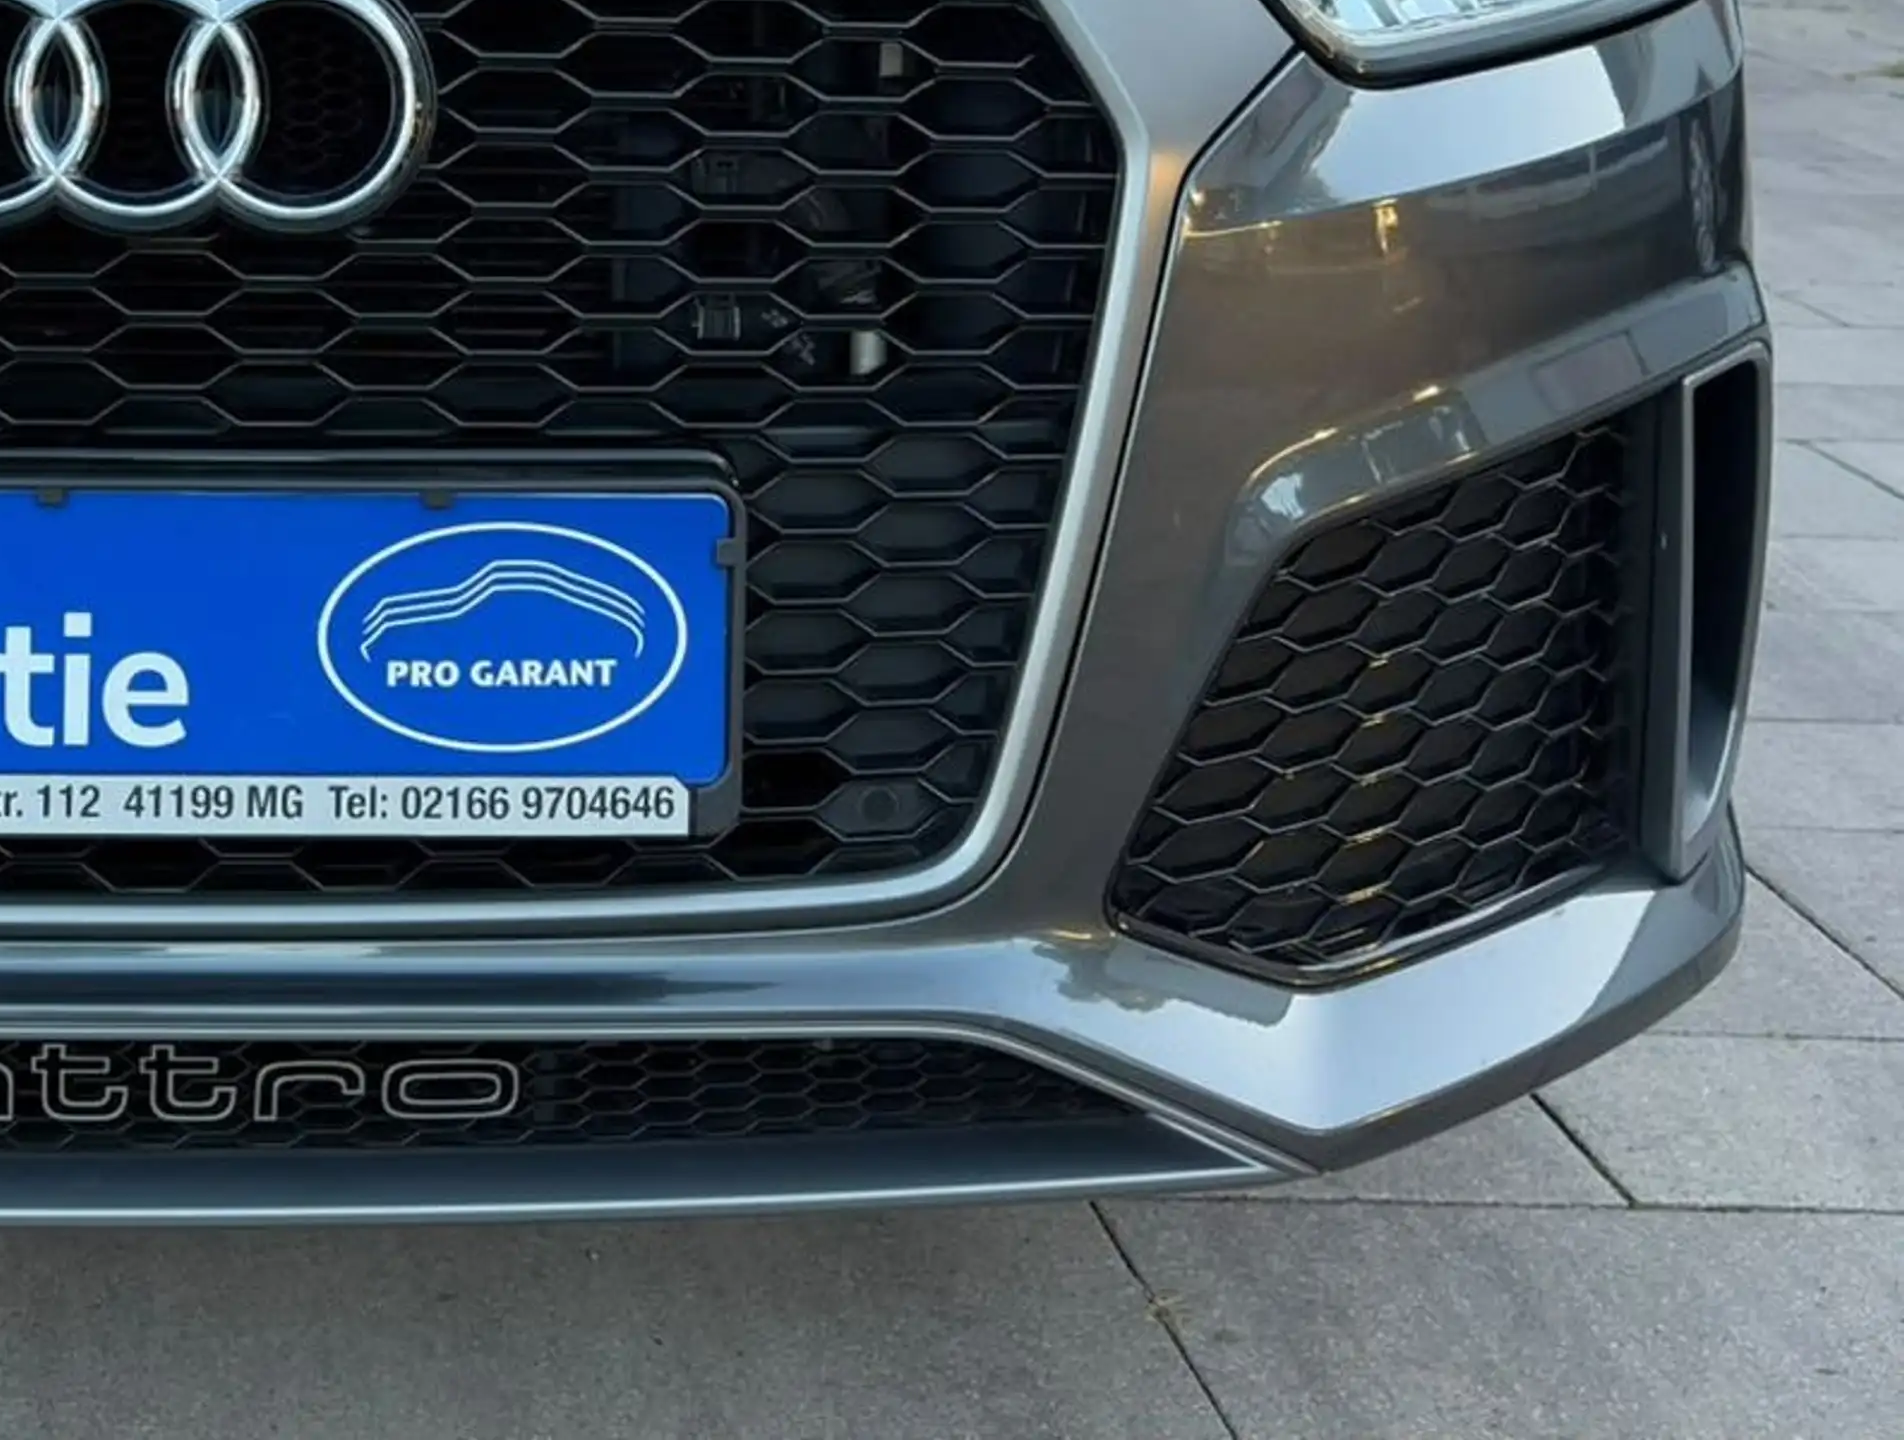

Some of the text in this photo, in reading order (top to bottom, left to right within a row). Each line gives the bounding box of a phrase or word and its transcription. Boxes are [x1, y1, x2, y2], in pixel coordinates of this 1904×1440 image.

[386, 659, 617, 687] PRO GARANT
[38, 784, 101, 819] 112
[124, 785, 234, 820] 41199
[247, 786, 304, 820] MG
[328, 786, 389, 820] Tel:
[400, 787, 510, 821] 02166
[522, 787, 675, 821] 9704646
